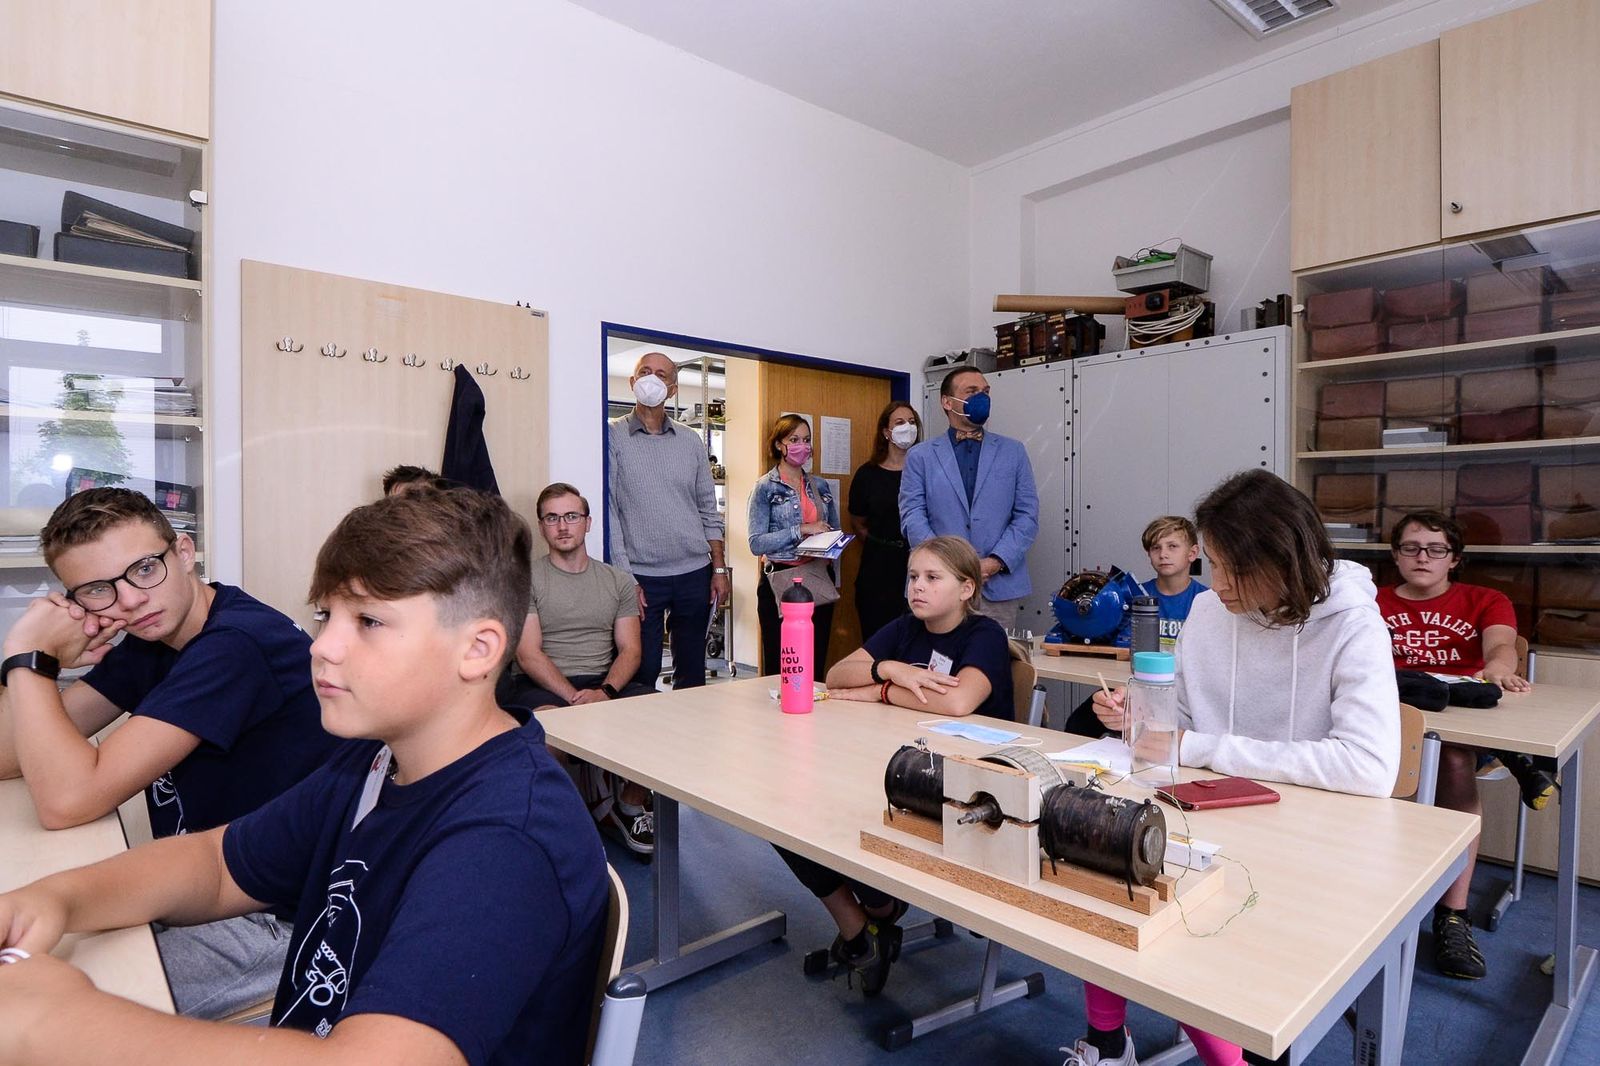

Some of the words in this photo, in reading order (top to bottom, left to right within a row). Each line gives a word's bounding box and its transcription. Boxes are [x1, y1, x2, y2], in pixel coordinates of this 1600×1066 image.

[1419, 611, 1478, 641] VALLEY
[1406, 630, 1439, 647] CC
[782, 646, 796, 655] ALL
[782, 656, 799, 665] YOU
[782, 665, 804, 674] NEED
[782, 676, 789, 684] IS
